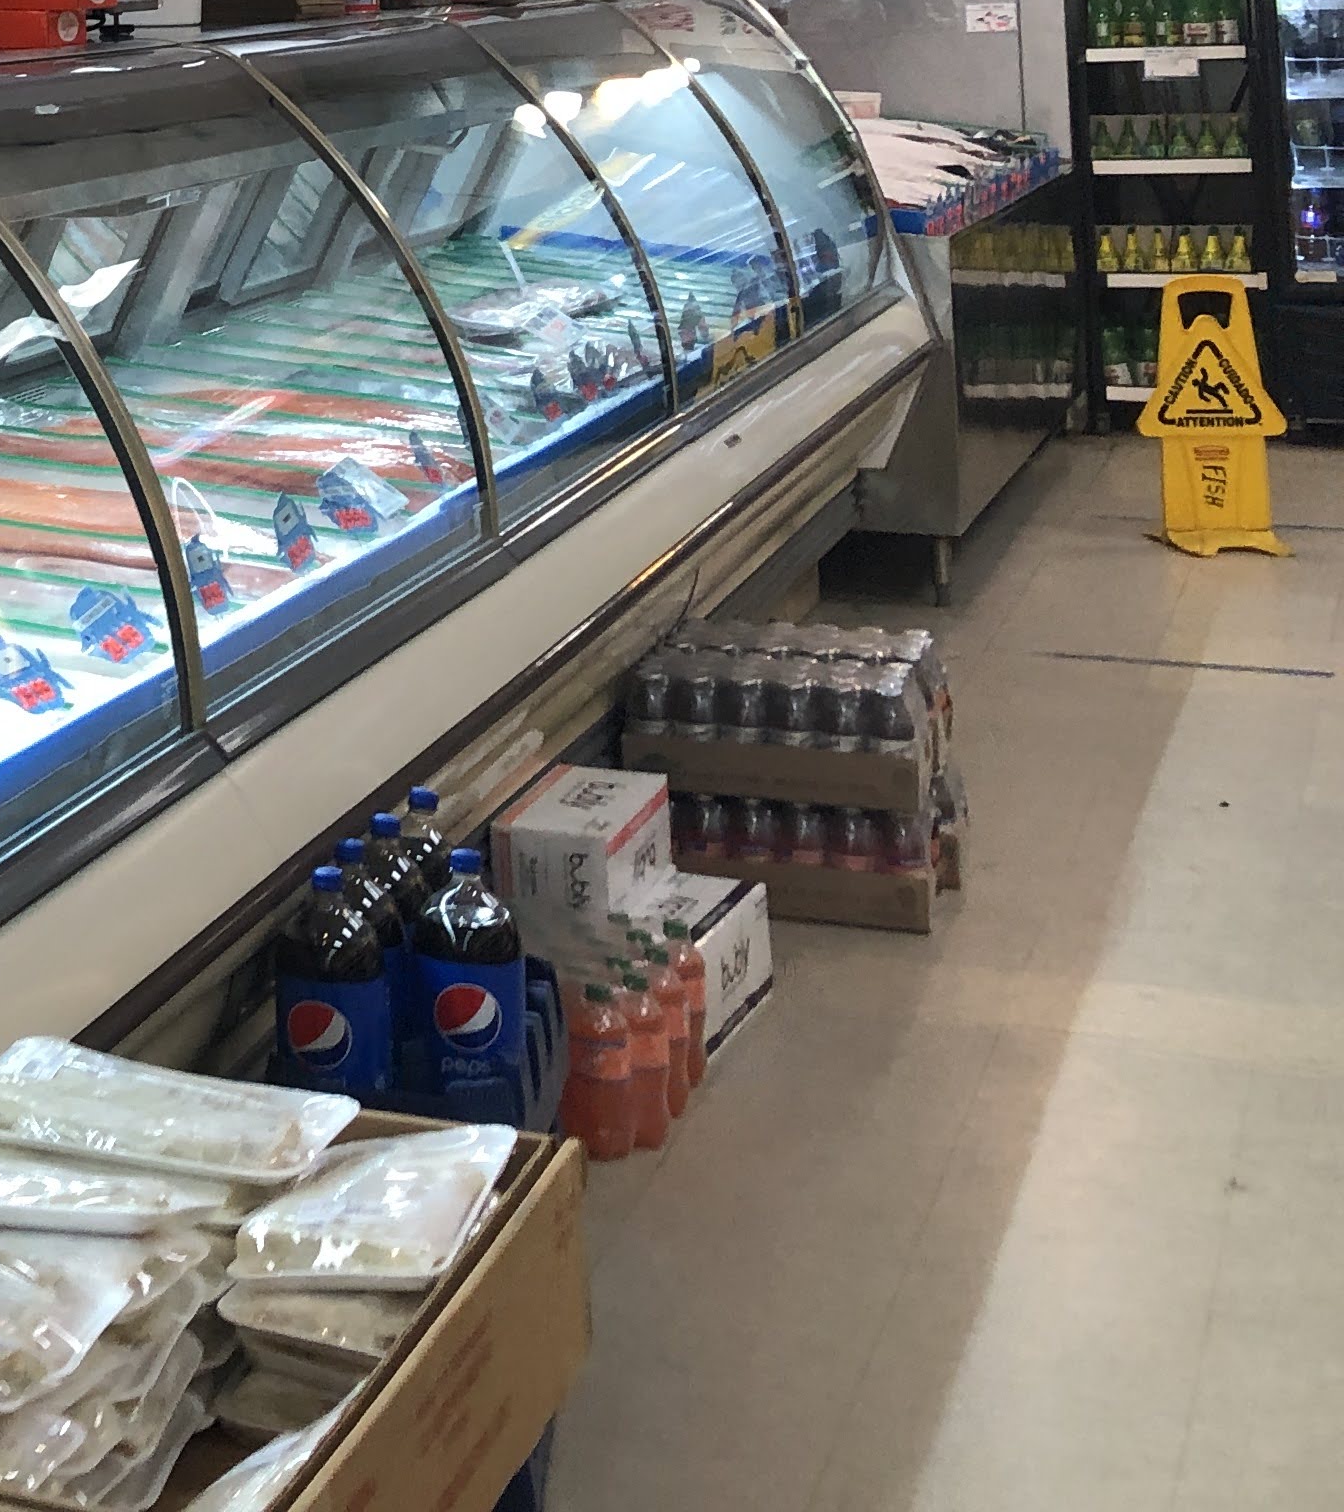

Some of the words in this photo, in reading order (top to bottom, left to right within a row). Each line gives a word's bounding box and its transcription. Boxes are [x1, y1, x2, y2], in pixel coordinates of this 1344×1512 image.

[1163, 356, 1198, 406] CAUTION
[1218, 357, 1255, 406] CUIDADO
[1176, 416, 1245, 428] ATTENTION
[1200, 464, 1228, 509] FISH
